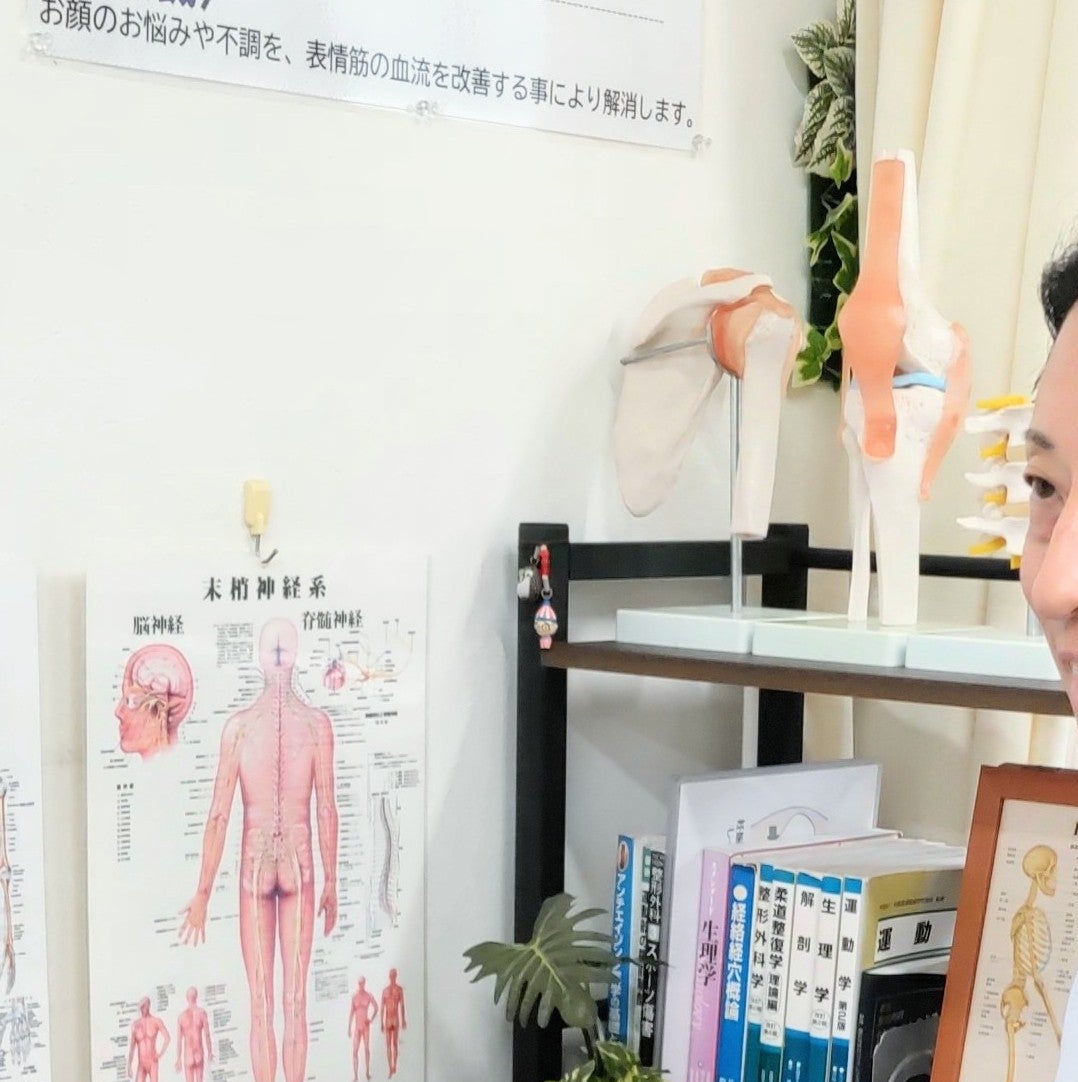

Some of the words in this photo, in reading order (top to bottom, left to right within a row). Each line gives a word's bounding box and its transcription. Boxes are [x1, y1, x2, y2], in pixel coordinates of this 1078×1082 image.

[39, 0, 693, 128] お顔のお悩みや不調を、表情筋の血流を改善する事により解消します。
[133, 615, 184, 635] 脳神経
[203, 575, 326, 601] 末梢神経系
[302, 610, 363, 631] 脊髄神経
[698, 920, 719, 987] 生理学
[751, 886, 771, 988] 整形外科学
[769, 886, 788, 969] 柔道整復学
[793, 890, 815, 996] 解剖学
[814, 899, 836, 1003] 生理学
[838, 898, 857, 991] 運動学
[877, 920, 932, 952] 運動
